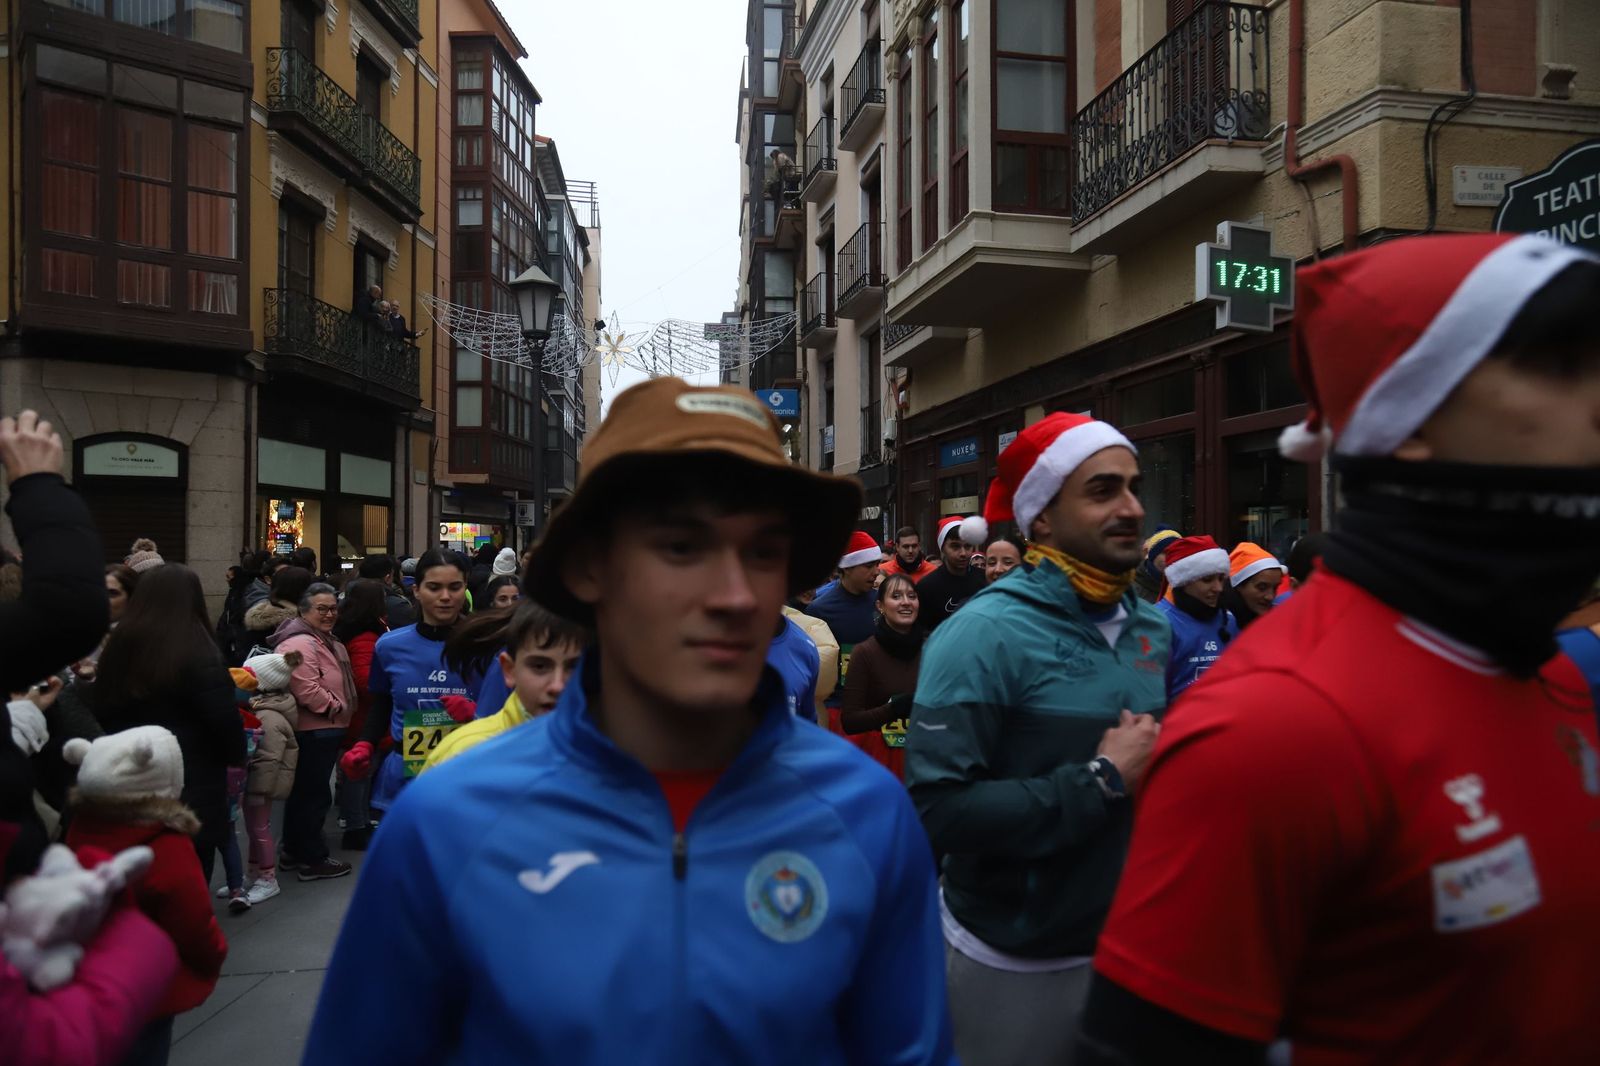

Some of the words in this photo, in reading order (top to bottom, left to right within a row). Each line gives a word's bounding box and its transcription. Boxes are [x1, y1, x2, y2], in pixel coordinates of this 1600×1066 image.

[1478, 172, 1506, 180] CALLE
[1533, 172, 1600, 216] TEAT
[1216, 260, 1280, 293] 17:31
[952, 445, 969, 457] NUXE
[1204, 641, 1218, 651] 46
[428, 670, 447, 682] 46
[408, 727, 457, 756] 24
